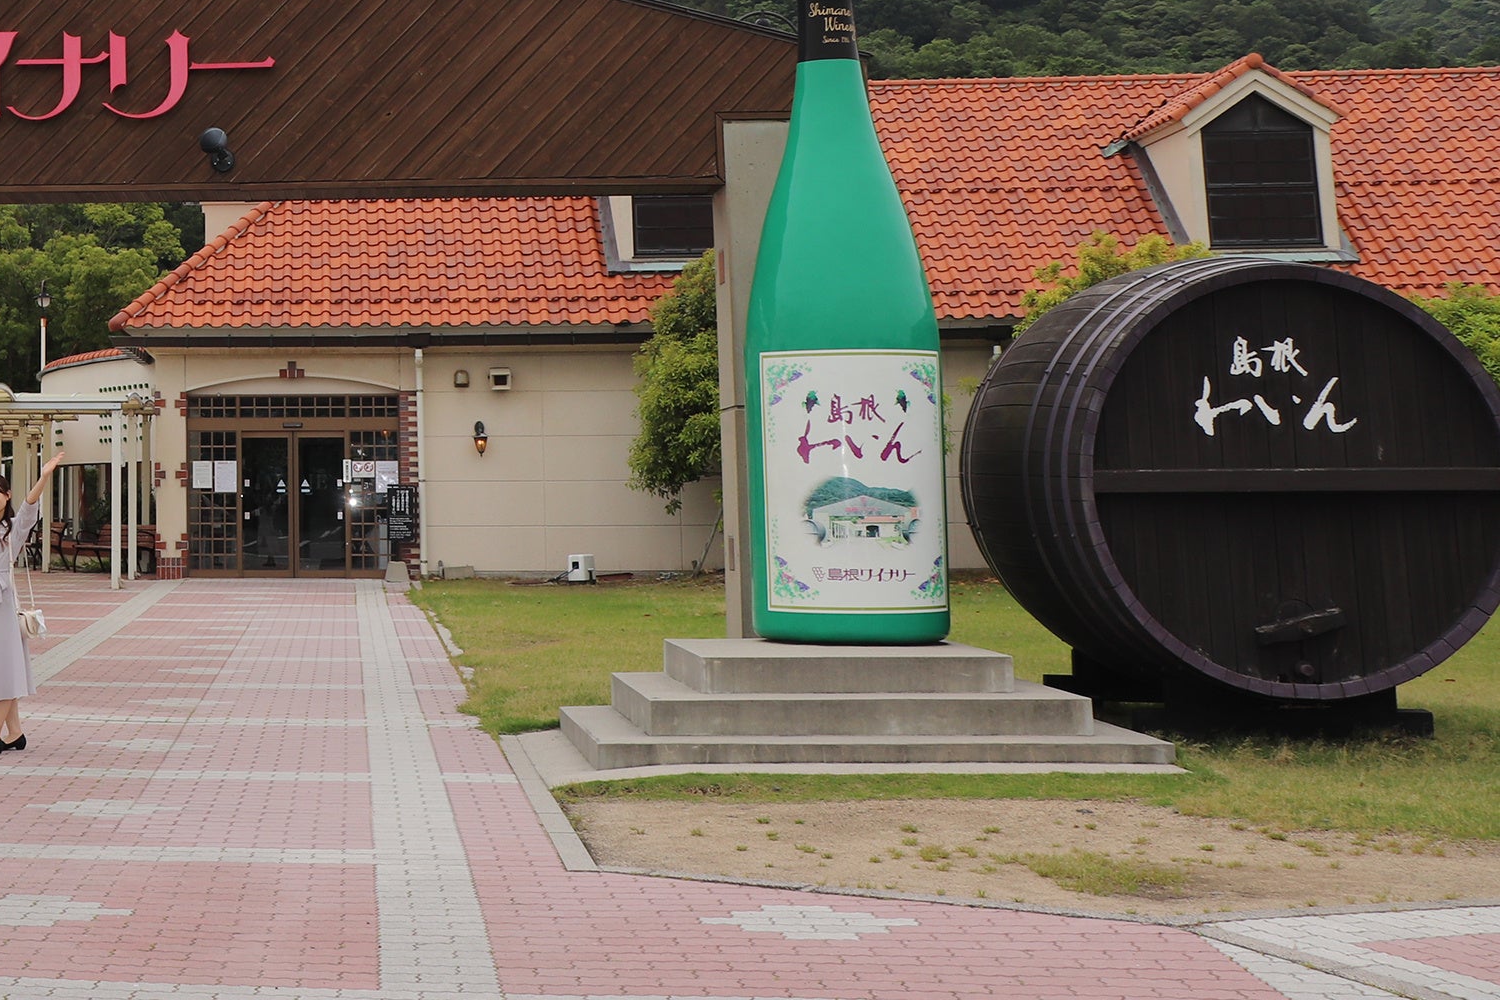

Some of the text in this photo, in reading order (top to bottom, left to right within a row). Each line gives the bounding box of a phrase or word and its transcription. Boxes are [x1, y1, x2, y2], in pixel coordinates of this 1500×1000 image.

[1229, 335, 1308, 377] 島根
[827, 393, 886, 424] 島根
[1193, 375, 1358, 436] わいん
[797, 419, 922, 464] わいん
[827, 568, 916, 582] 島根ワイナリー
